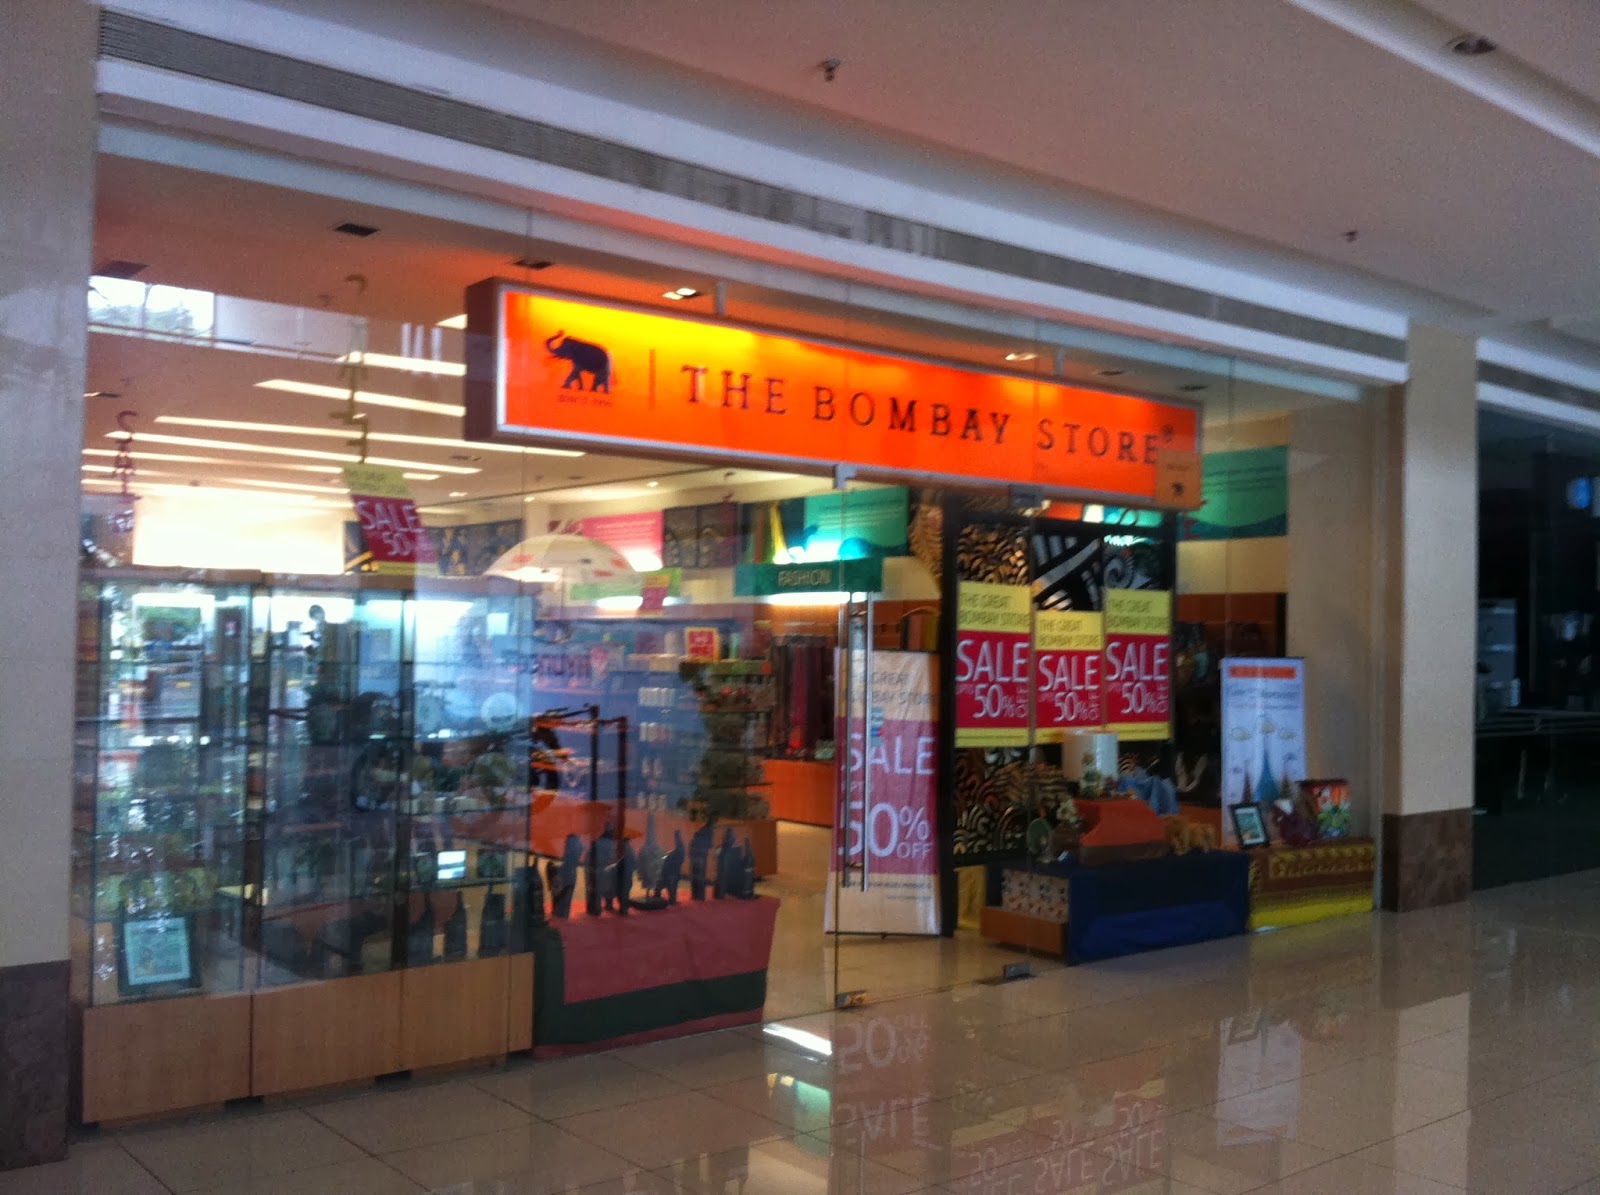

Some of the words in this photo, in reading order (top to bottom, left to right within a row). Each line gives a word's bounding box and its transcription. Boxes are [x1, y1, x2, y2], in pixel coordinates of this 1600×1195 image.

[681, 364, 788, 415] THE
[811, 386, 1011, 445] BOMBAY
[1035, 418, 1160, 466] STORE
[356, 500, 426, 535] SALE
[777, 568, 833, 588] FASHION
[956, 638, 1030, 683] SALE
[1037, 654, 1100, 692] SALE
[1104, 640, 1170, 682] SALE
[840, 731, 936, 776] SALE
[896, 841, 933, 860] OFF
